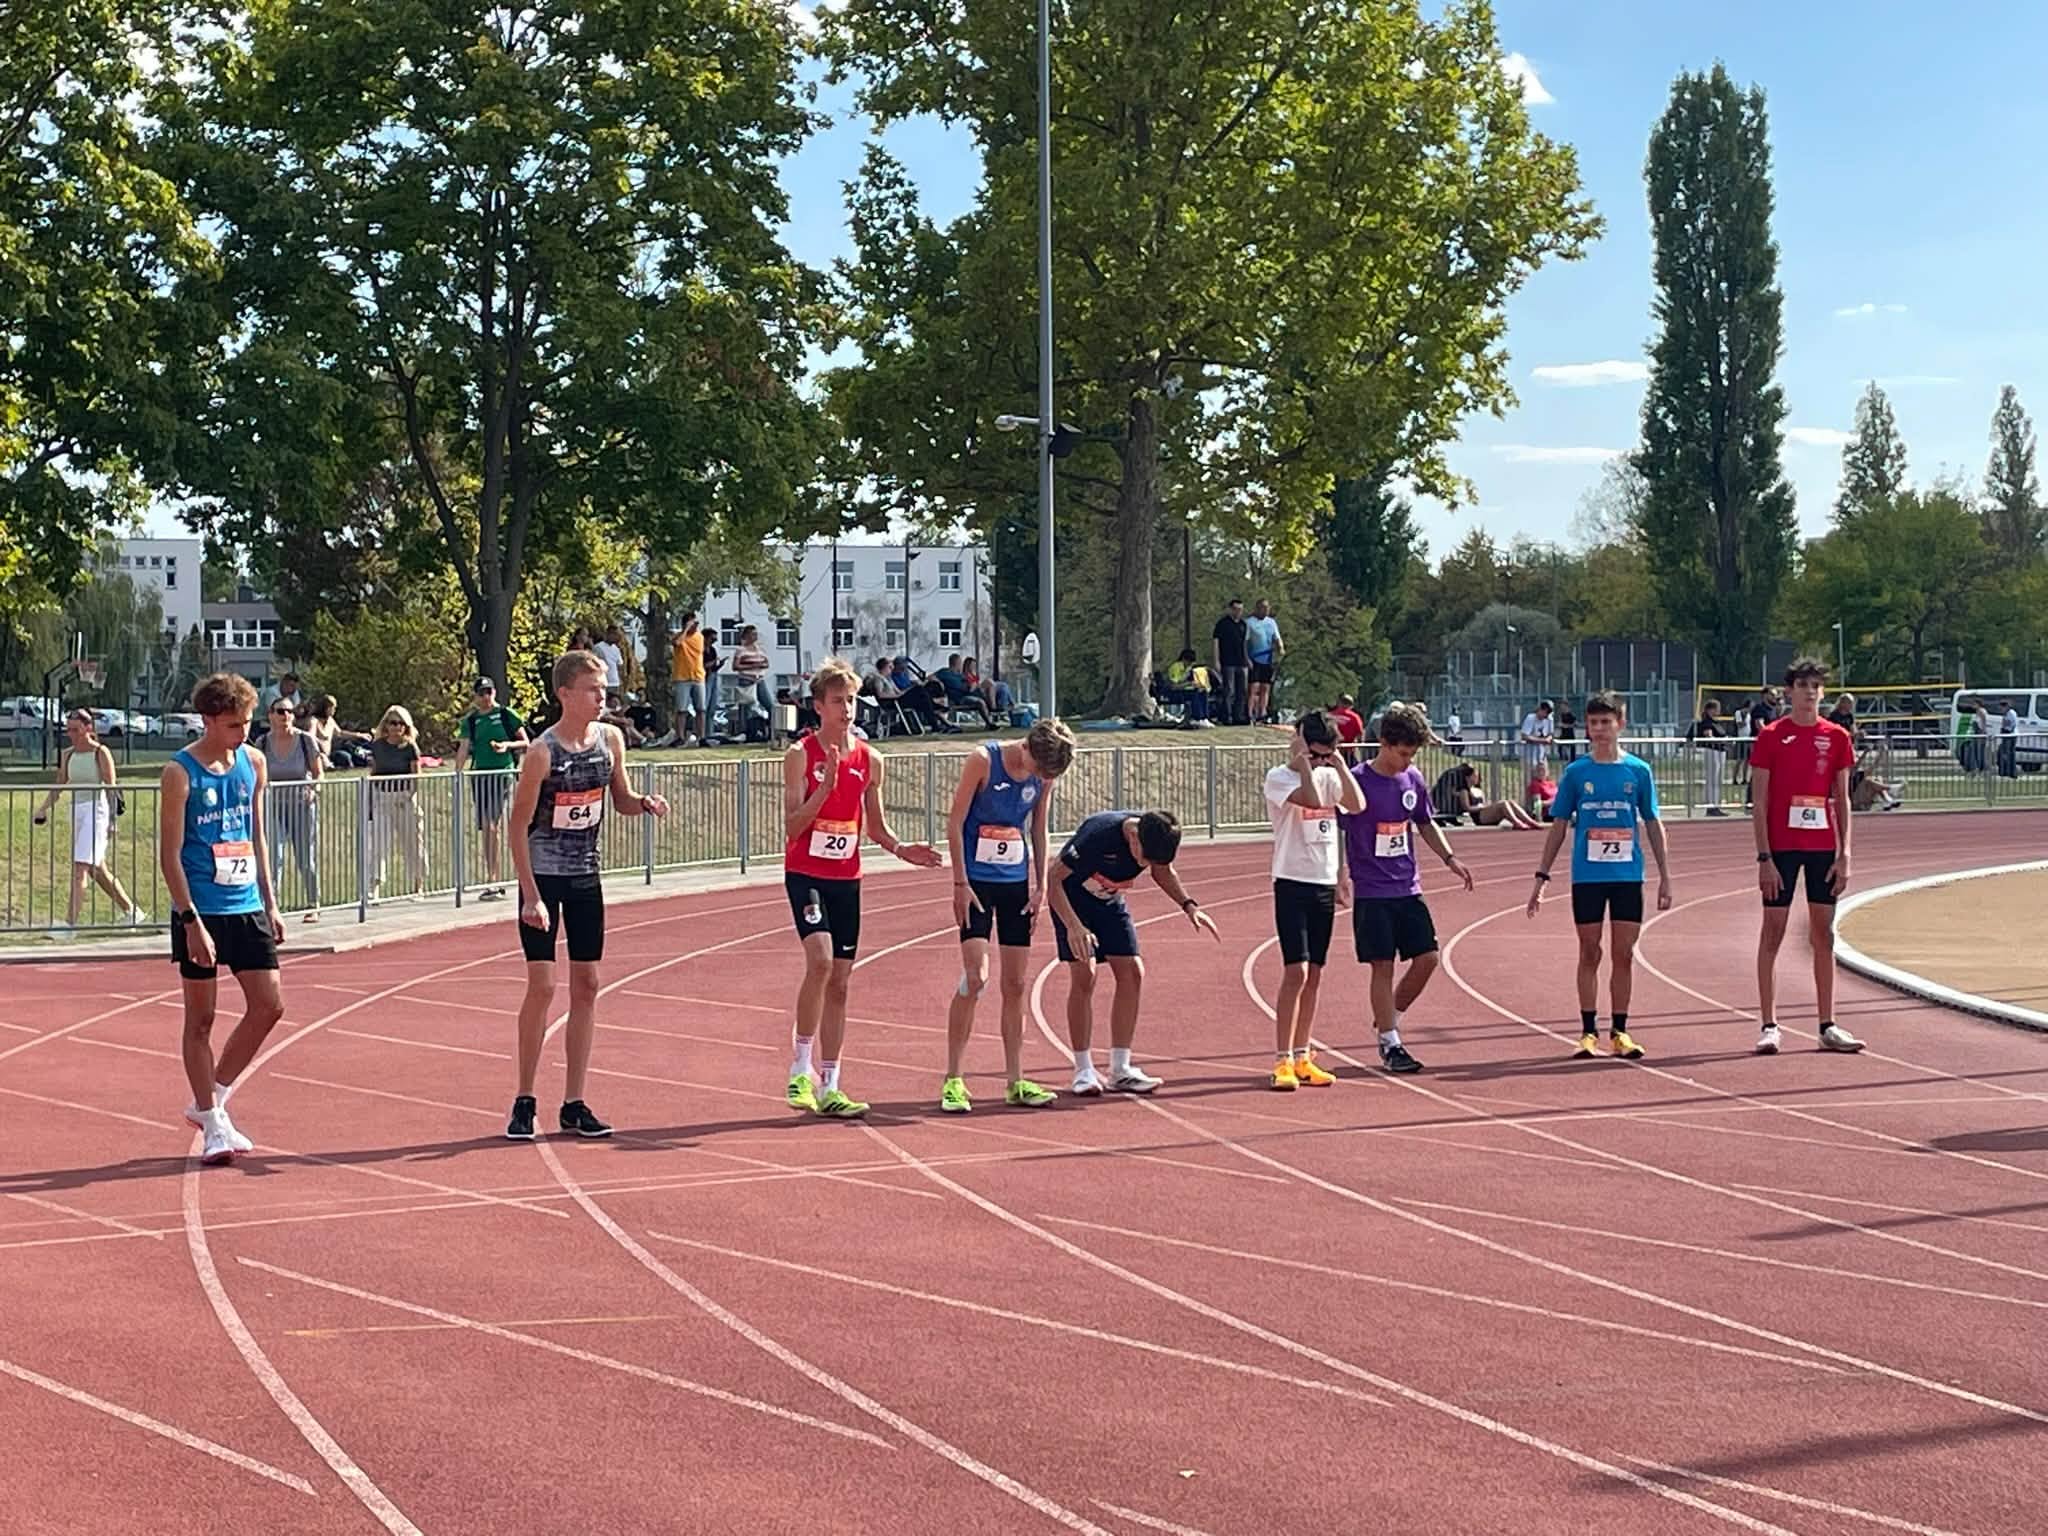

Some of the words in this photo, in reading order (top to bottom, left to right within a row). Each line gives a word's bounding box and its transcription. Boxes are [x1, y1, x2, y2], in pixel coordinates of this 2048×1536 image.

[569, 806, 591, 820] 64
[825, 836, 847, 850] 20
[997, 842, 1008, 855] 9
[1390, 835, 1404, 849] 53
[1601, 842, 1620, 854] 73
[230, 859, 248, 874] 72
